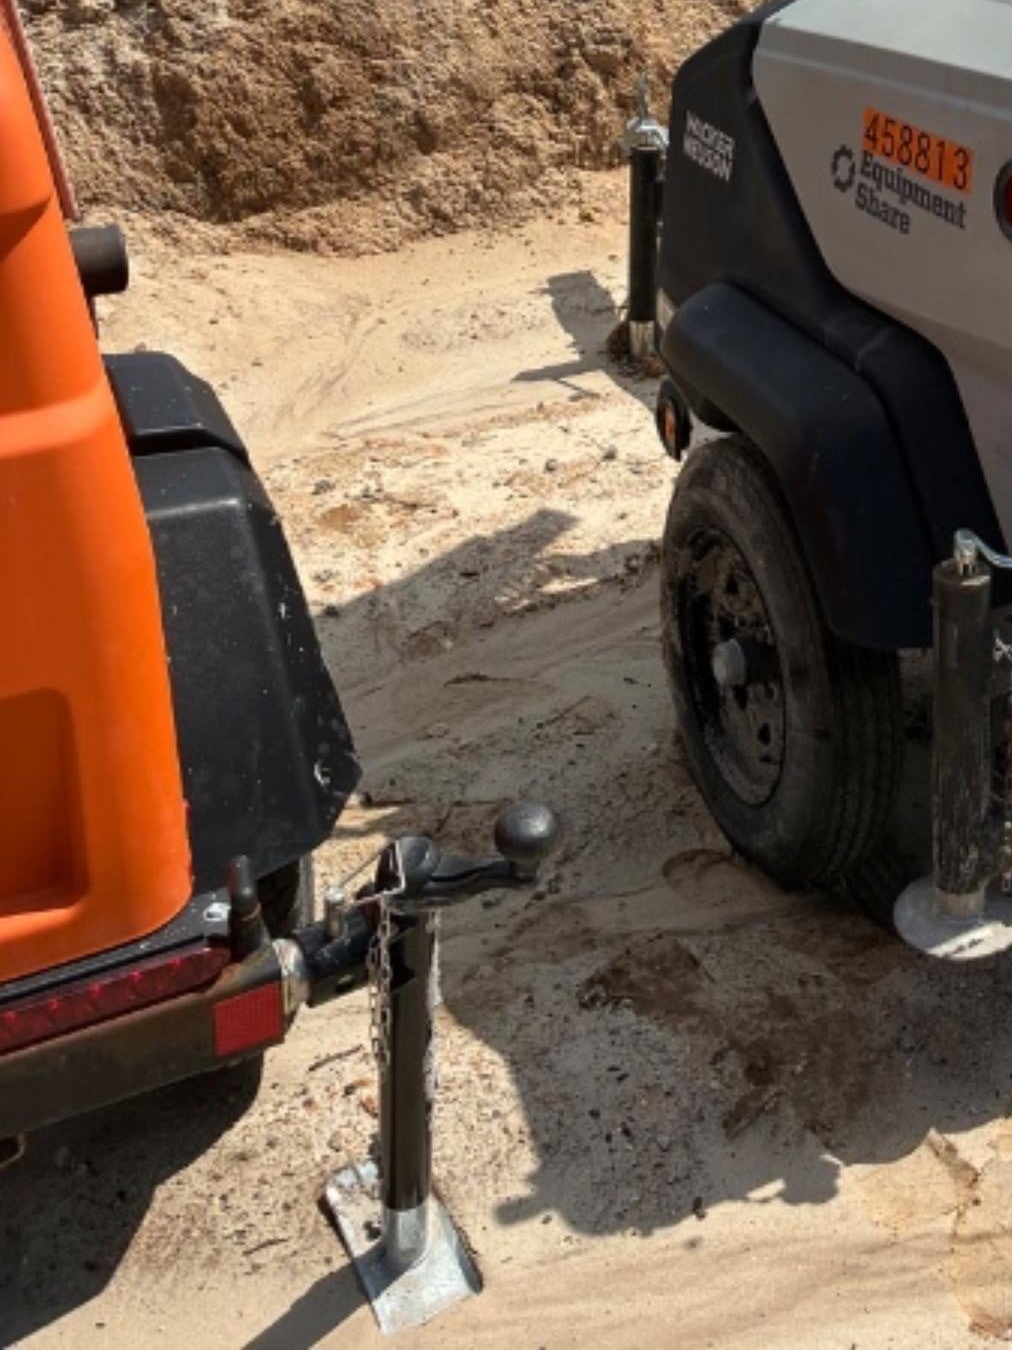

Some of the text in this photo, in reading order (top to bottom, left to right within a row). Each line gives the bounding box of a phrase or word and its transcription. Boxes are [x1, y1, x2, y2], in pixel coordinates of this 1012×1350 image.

[864, 112, 970, 191] 458813
[854, 181, 910, 235] Share
[860, 154, 967, 230] Equipment
